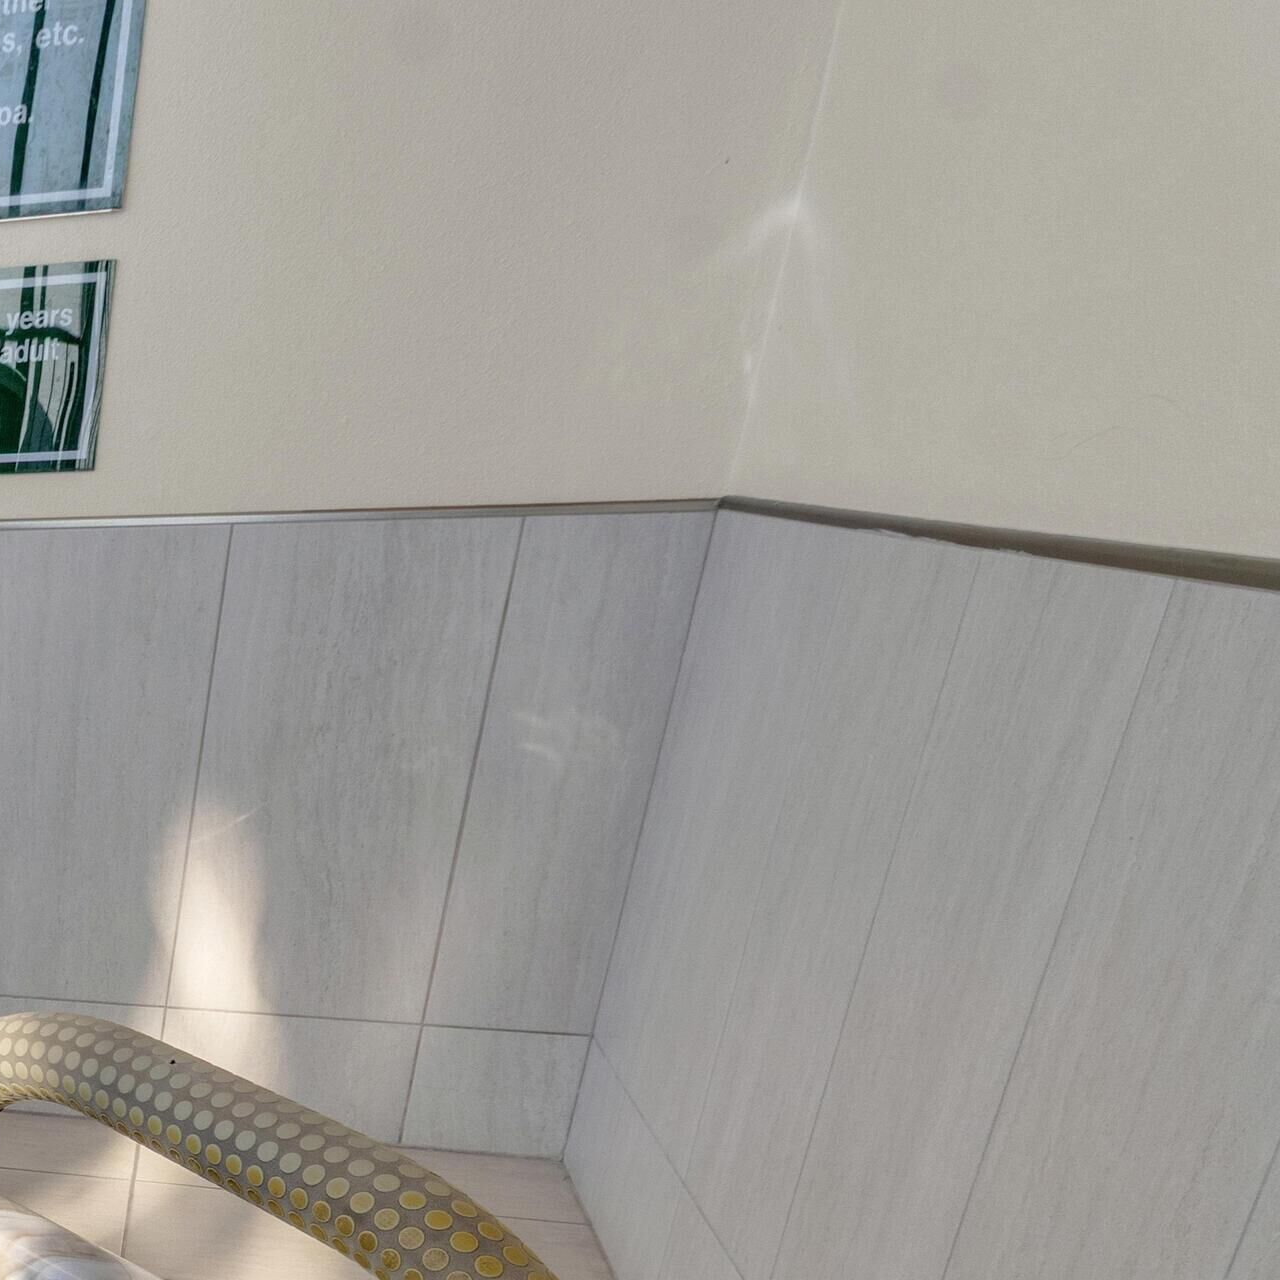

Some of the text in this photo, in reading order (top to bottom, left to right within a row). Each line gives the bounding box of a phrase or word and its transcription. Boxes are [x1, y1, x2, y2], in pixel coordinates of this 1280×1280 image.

[36, 22, 84, 48] etc.
[5, 307, 72, 335] years
[0, 337, 59, 363] adult
